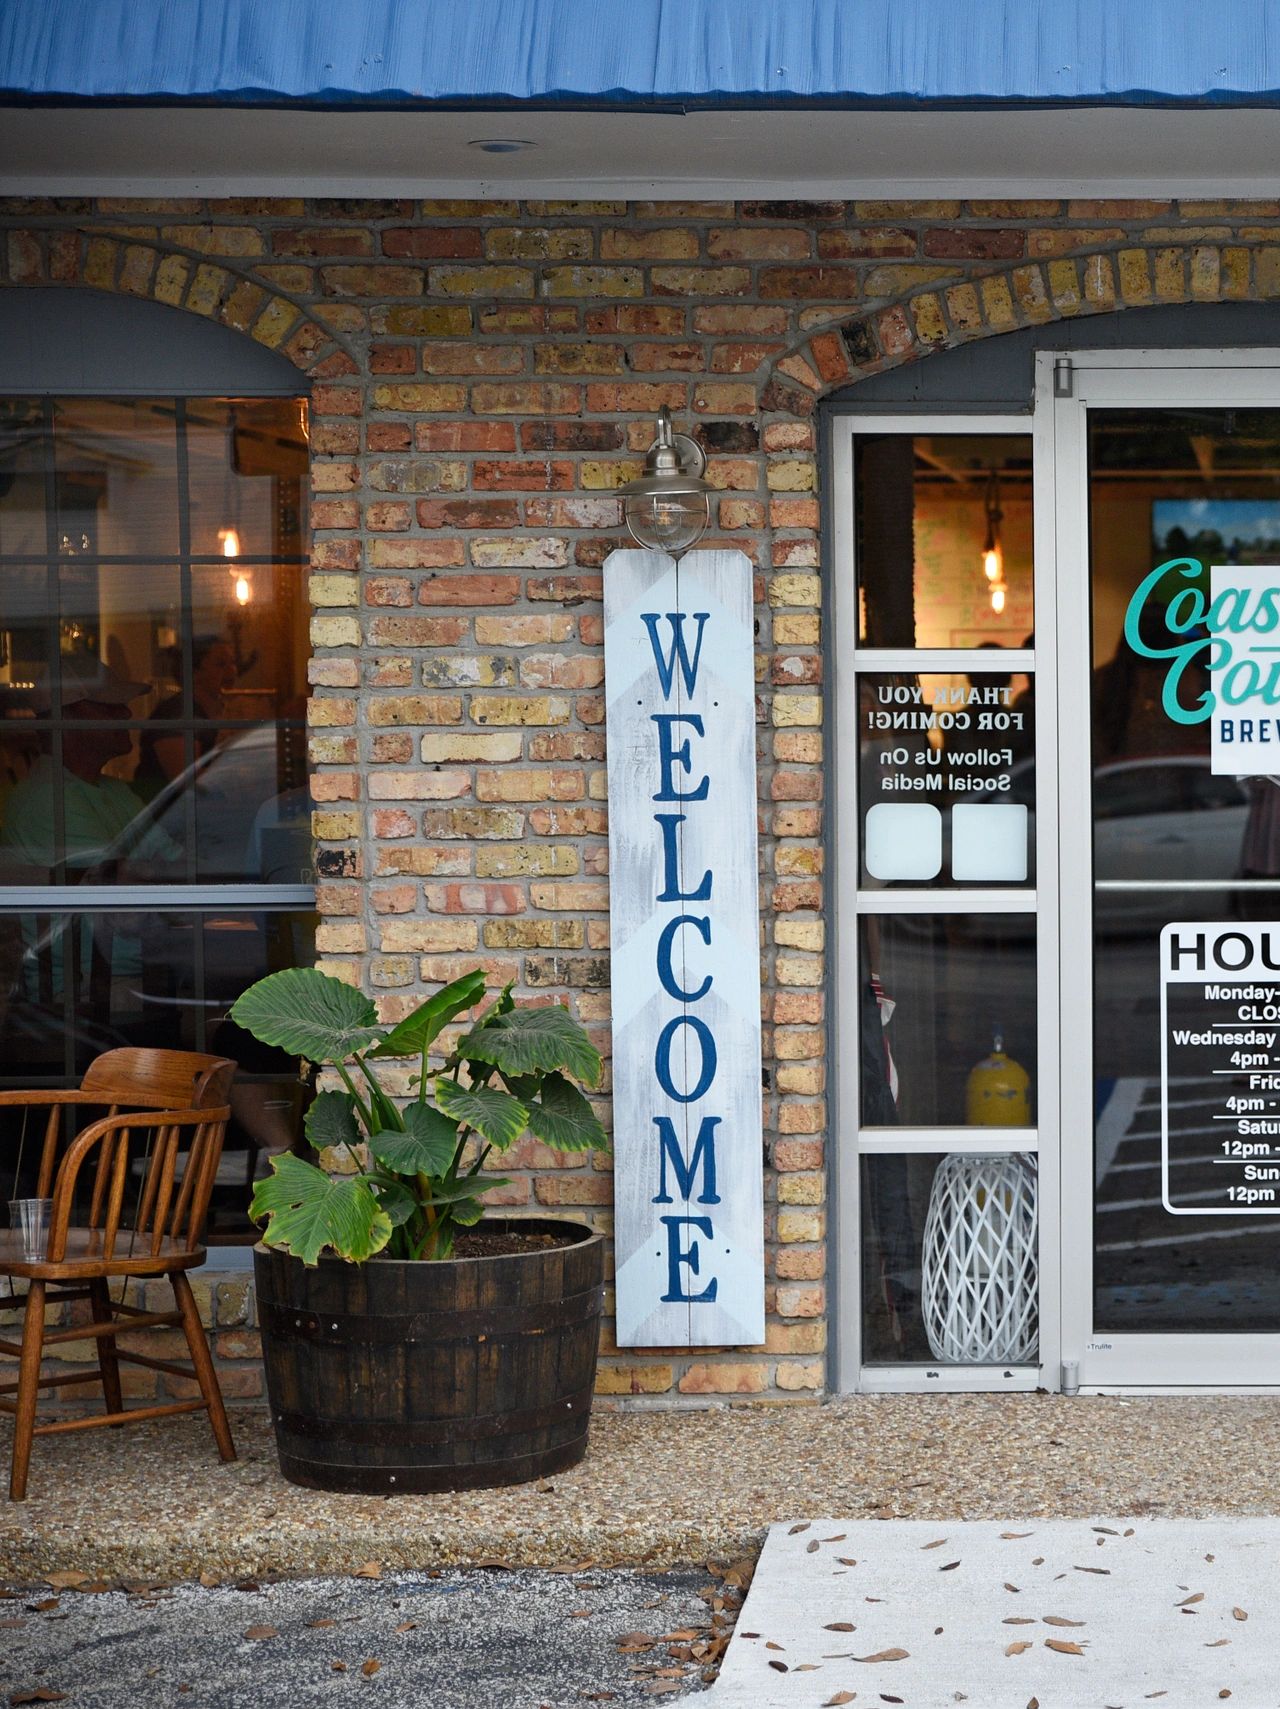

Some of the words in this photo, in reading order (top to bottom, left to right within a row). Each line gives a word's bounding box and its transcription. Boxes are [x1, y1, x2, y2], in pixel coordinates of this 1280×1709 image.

[640, 612, 721, 1303] WELCOME
[1172, 1029, 1276, 1049] Wednesday
[1230, 1050, 1269, 1069] 4pm
[1225, 1095, 1265, 1114] 4pm
[1221, 1140, 1270, 1159] 12pm
[1226, 1186, 1275, 1205] 12pm
